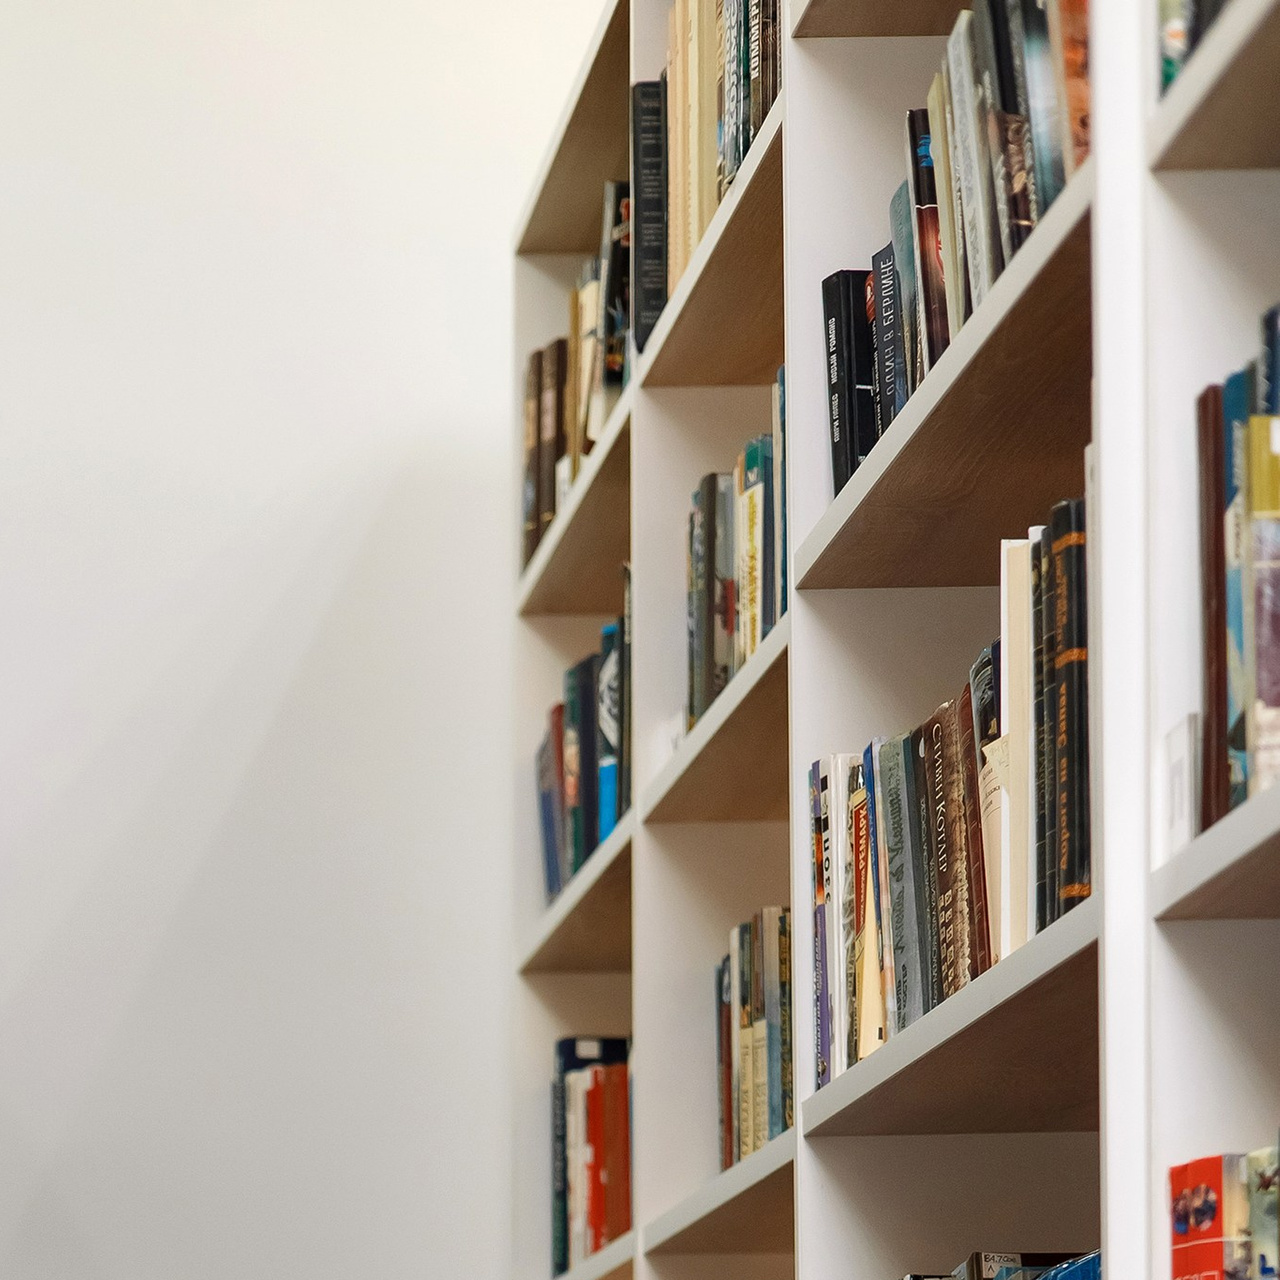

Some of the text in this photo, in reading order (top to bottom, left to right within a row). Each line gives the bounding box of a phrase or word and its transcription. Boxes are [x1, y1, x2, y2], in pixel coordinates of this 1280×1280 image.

[749, 0, 760, 81] КОММЕР
[881, 255, 895, 396] ОДИН В БЕРЛИНЕ
[830, 353, 838, 385] НОВЫЙ
[932, 722, 945, 800] СТИВЕН
[858, 807, 868, 870] РЕМАРК
[935, 801, 948, 874] КОТЛЕР
